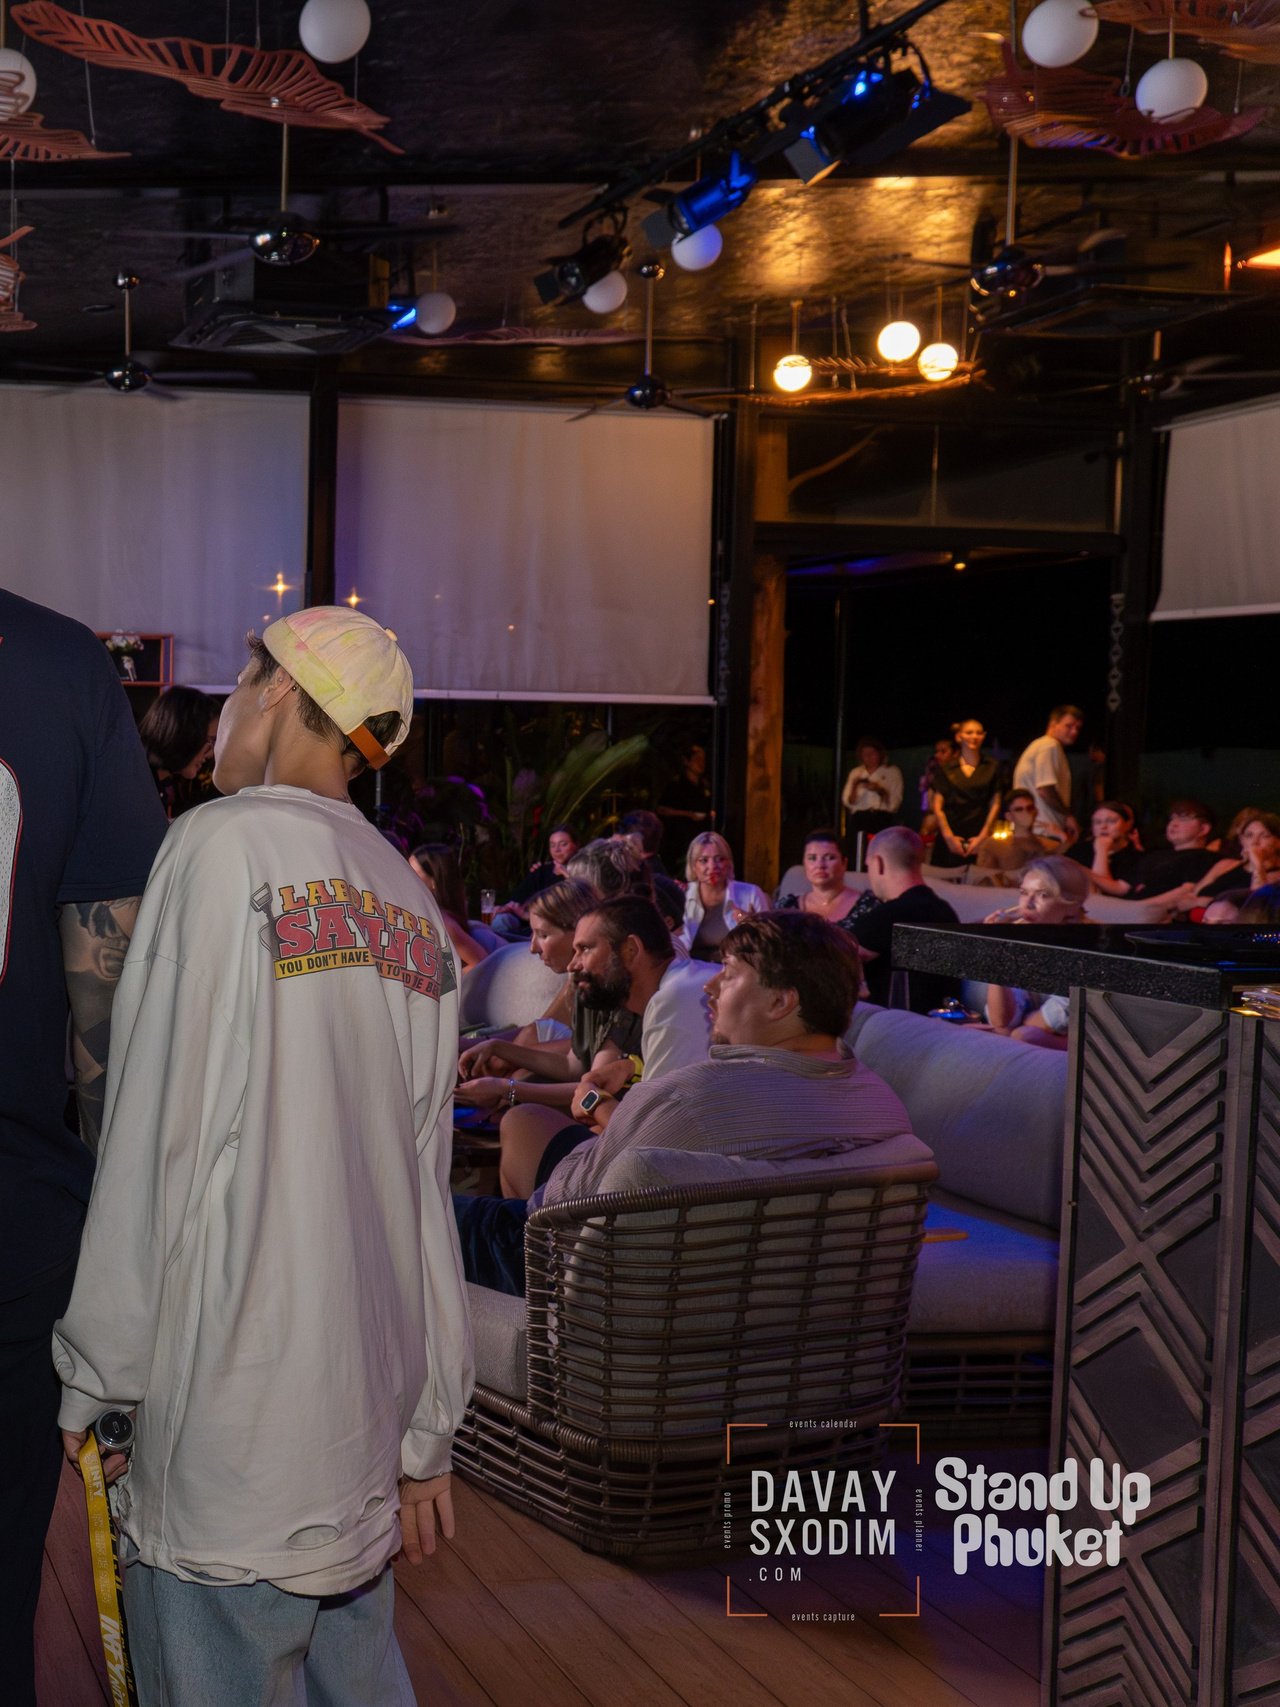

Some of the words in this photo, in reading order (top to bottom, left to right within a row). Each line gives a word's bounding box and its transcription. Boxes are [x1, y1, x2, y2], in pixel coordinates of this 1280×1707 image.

[278, 878, 385, 916] LABOR
[384, 902, 442, 949] FRE
[278, 959, 304, 976] YOU
[309, 953, 339, 970] DON'T
[340, 951, 370, 964] HAVE
[386, 964, 401, 977] TO
[89, 1464, 104, 1498] INFY
